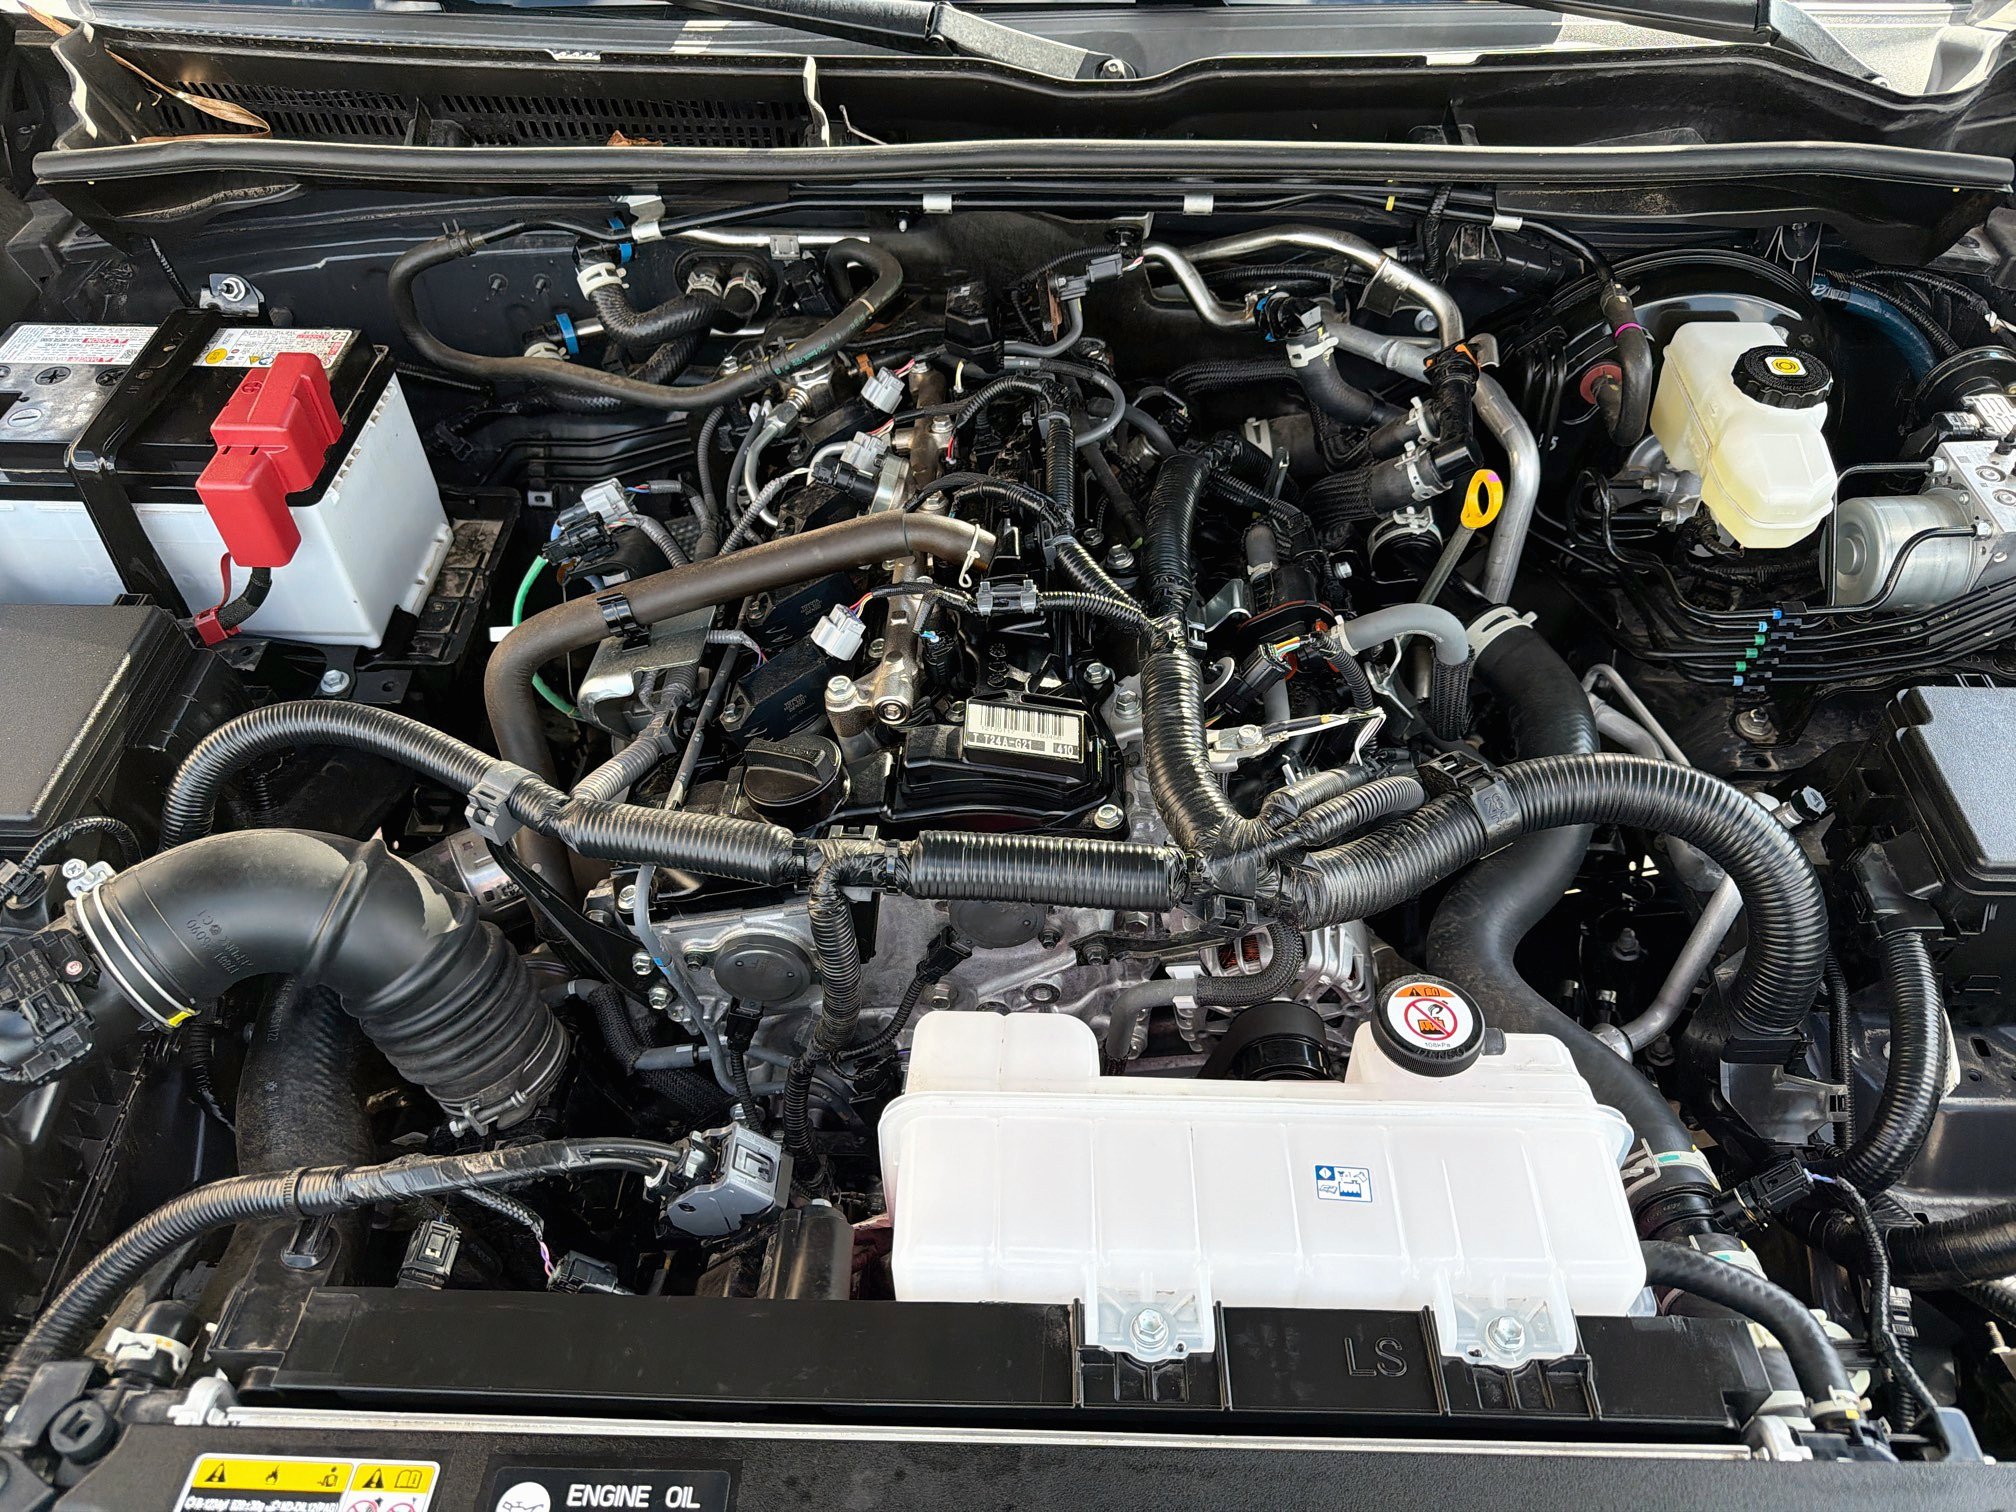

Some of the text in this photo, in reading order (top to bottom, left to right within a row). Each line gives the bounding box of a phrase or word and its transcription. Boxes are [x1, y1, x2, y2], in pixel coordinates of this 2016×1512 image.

[973, 732, 1033, 750] T T24A-G21
[1057, 744, 1074, 756] 410
[1344, 1337, 1408, 1377] LS
[565, 1483, 701, 1509] ENGINE OIL
